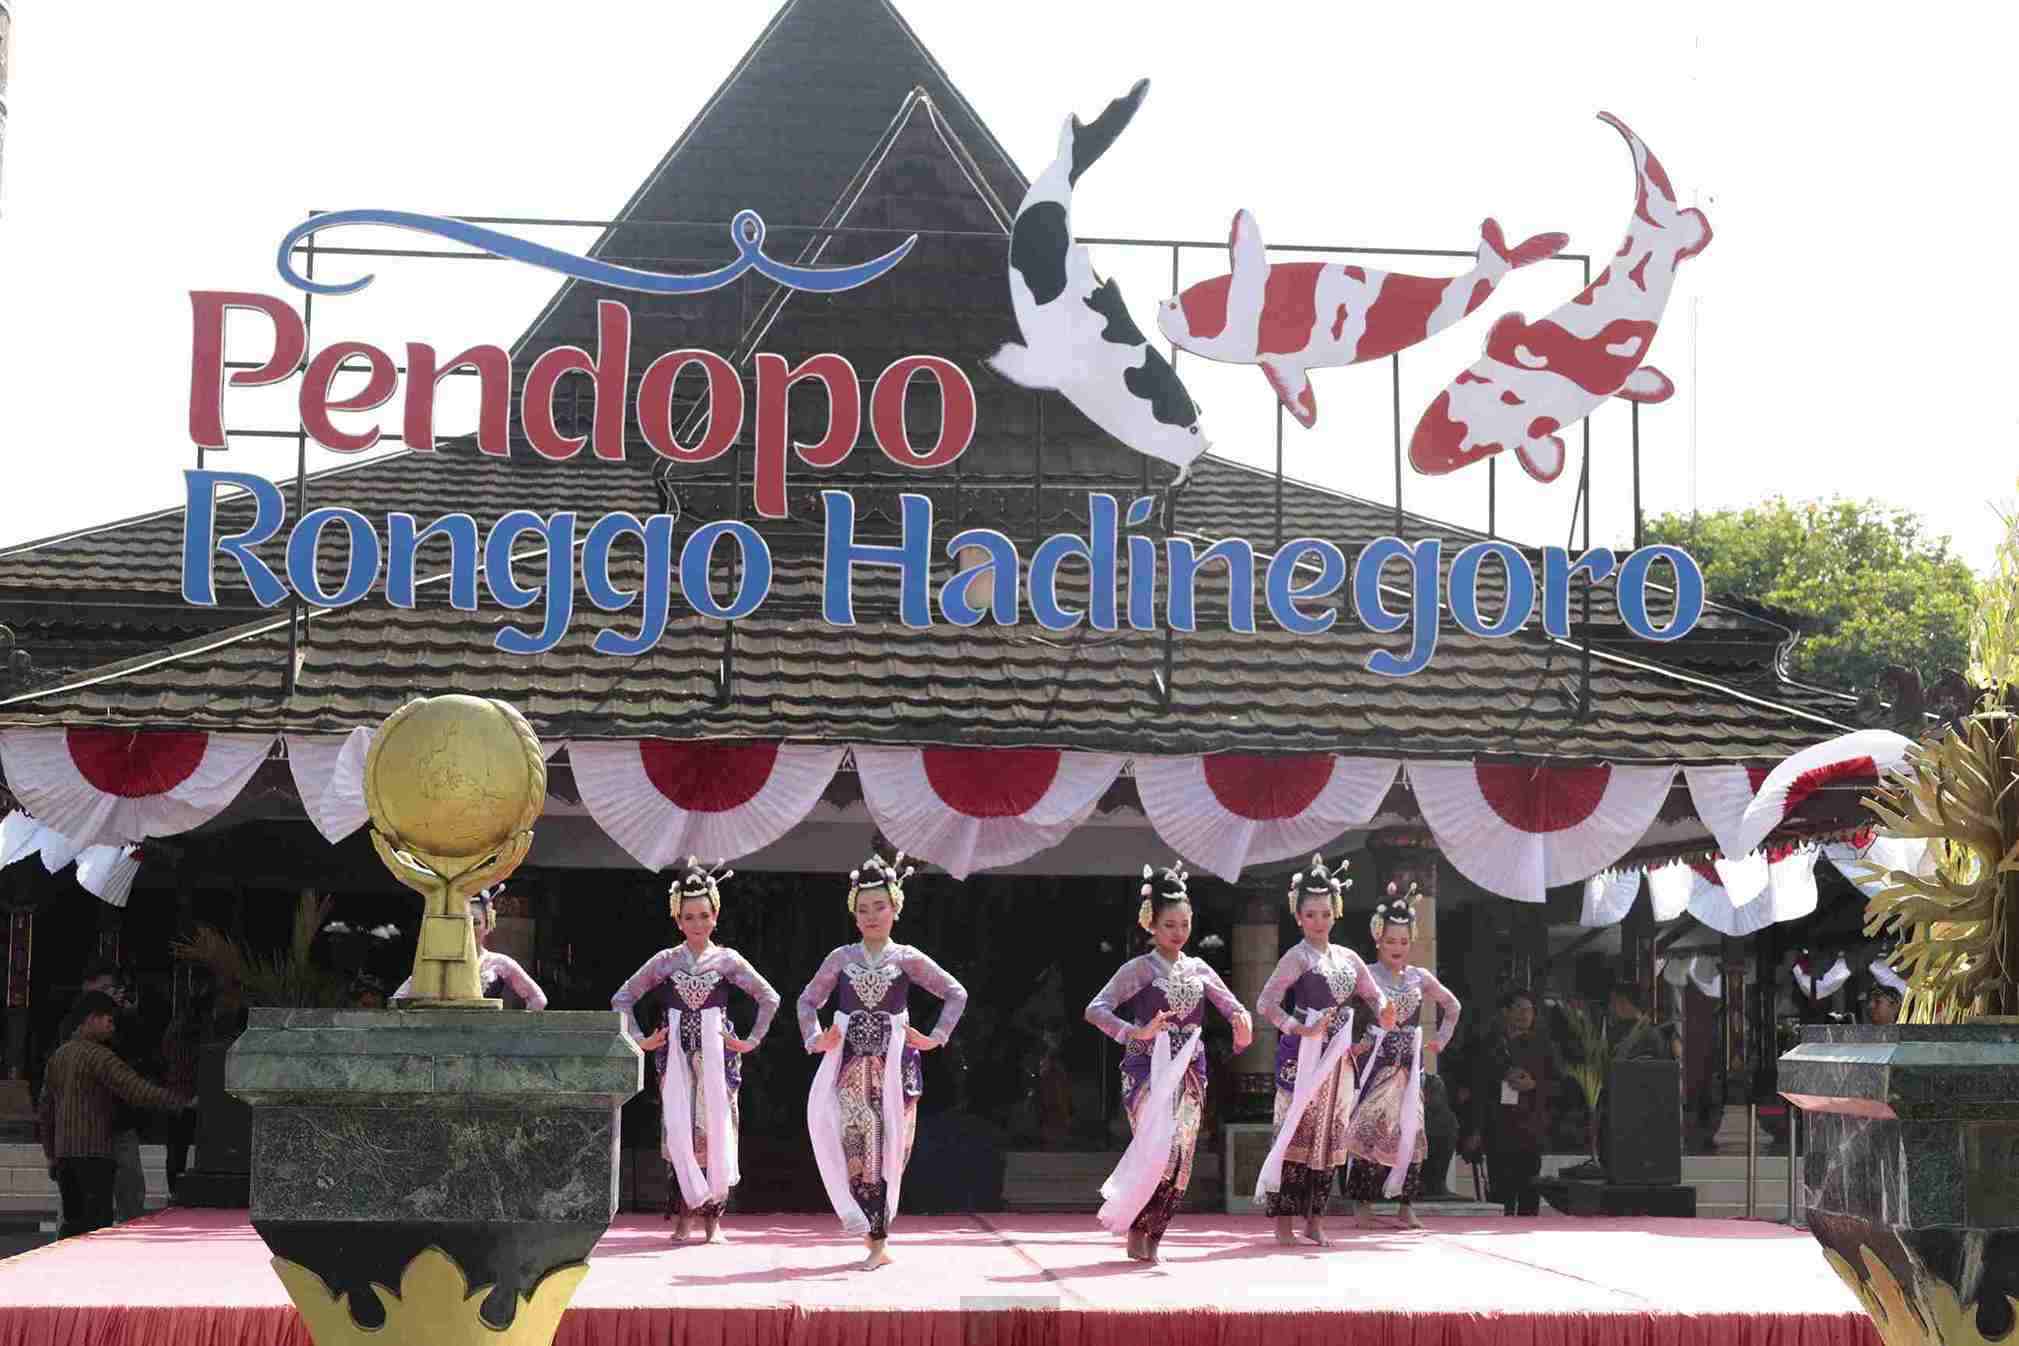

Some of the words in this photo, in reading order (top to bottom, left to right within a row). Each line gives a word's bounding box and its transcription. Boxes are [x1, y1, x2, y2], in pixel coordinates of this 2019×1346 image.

[189, 290, 977, 518] Pendopo
[181, 470, 773, 655] Ronggo
[821, 489, 1705, 675] Hadinegoro
